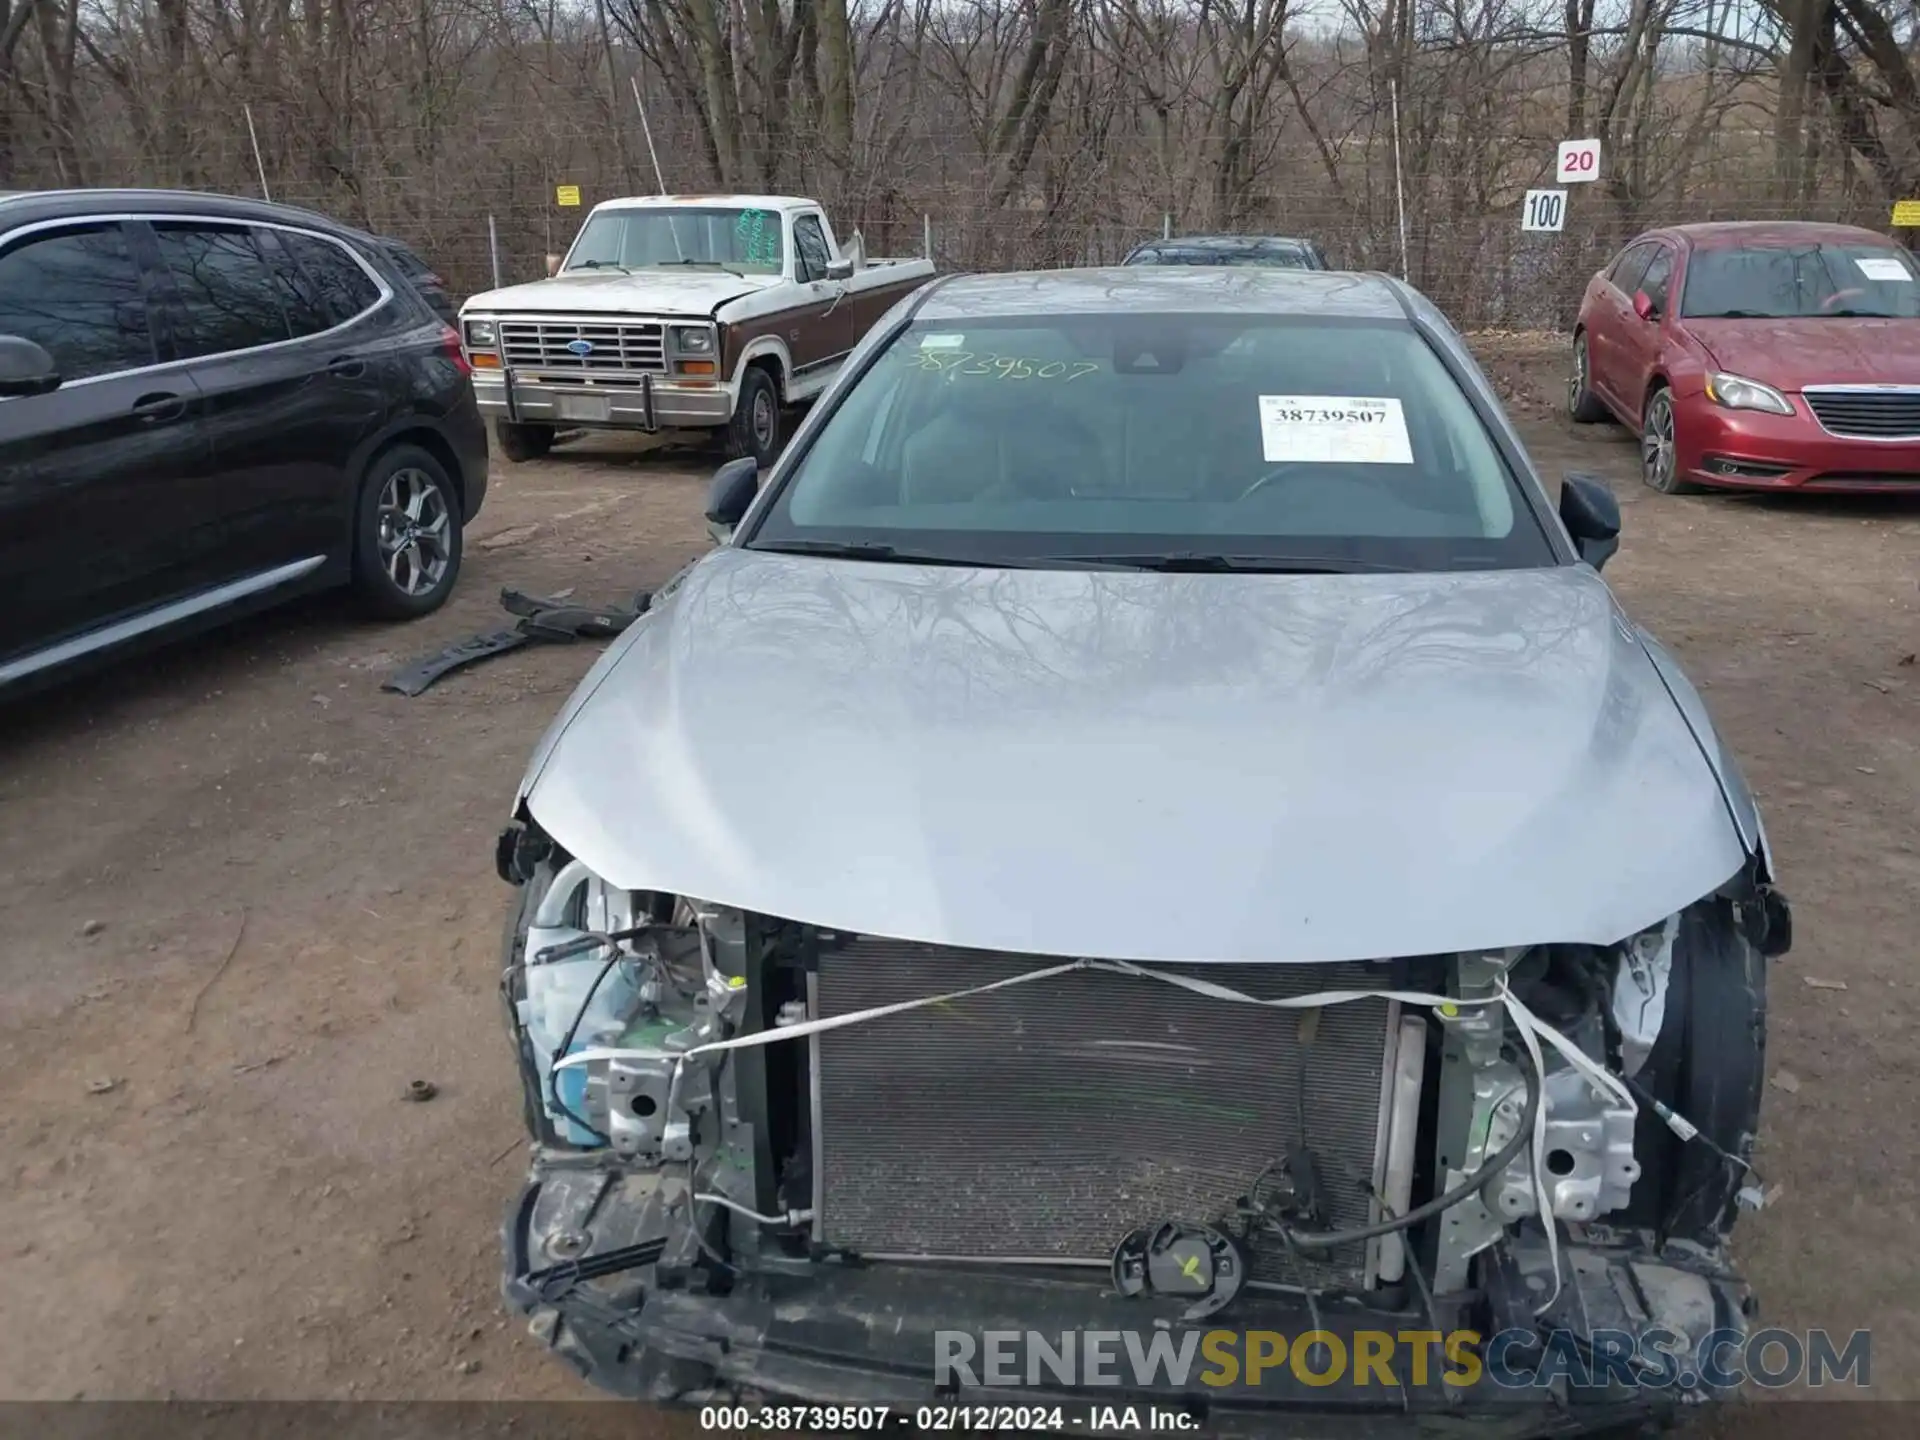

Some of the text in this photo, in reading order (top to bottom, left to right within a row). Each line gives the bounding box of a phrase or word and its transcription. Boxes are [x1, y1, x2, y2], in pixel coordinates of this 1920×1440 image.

[1564, 151, 1593, 172] 20
[1530, 194, 1561, 227] 100
[905, 351, 1099, 381] 38739507
[1274, 408, 1386, 423] 38739507
